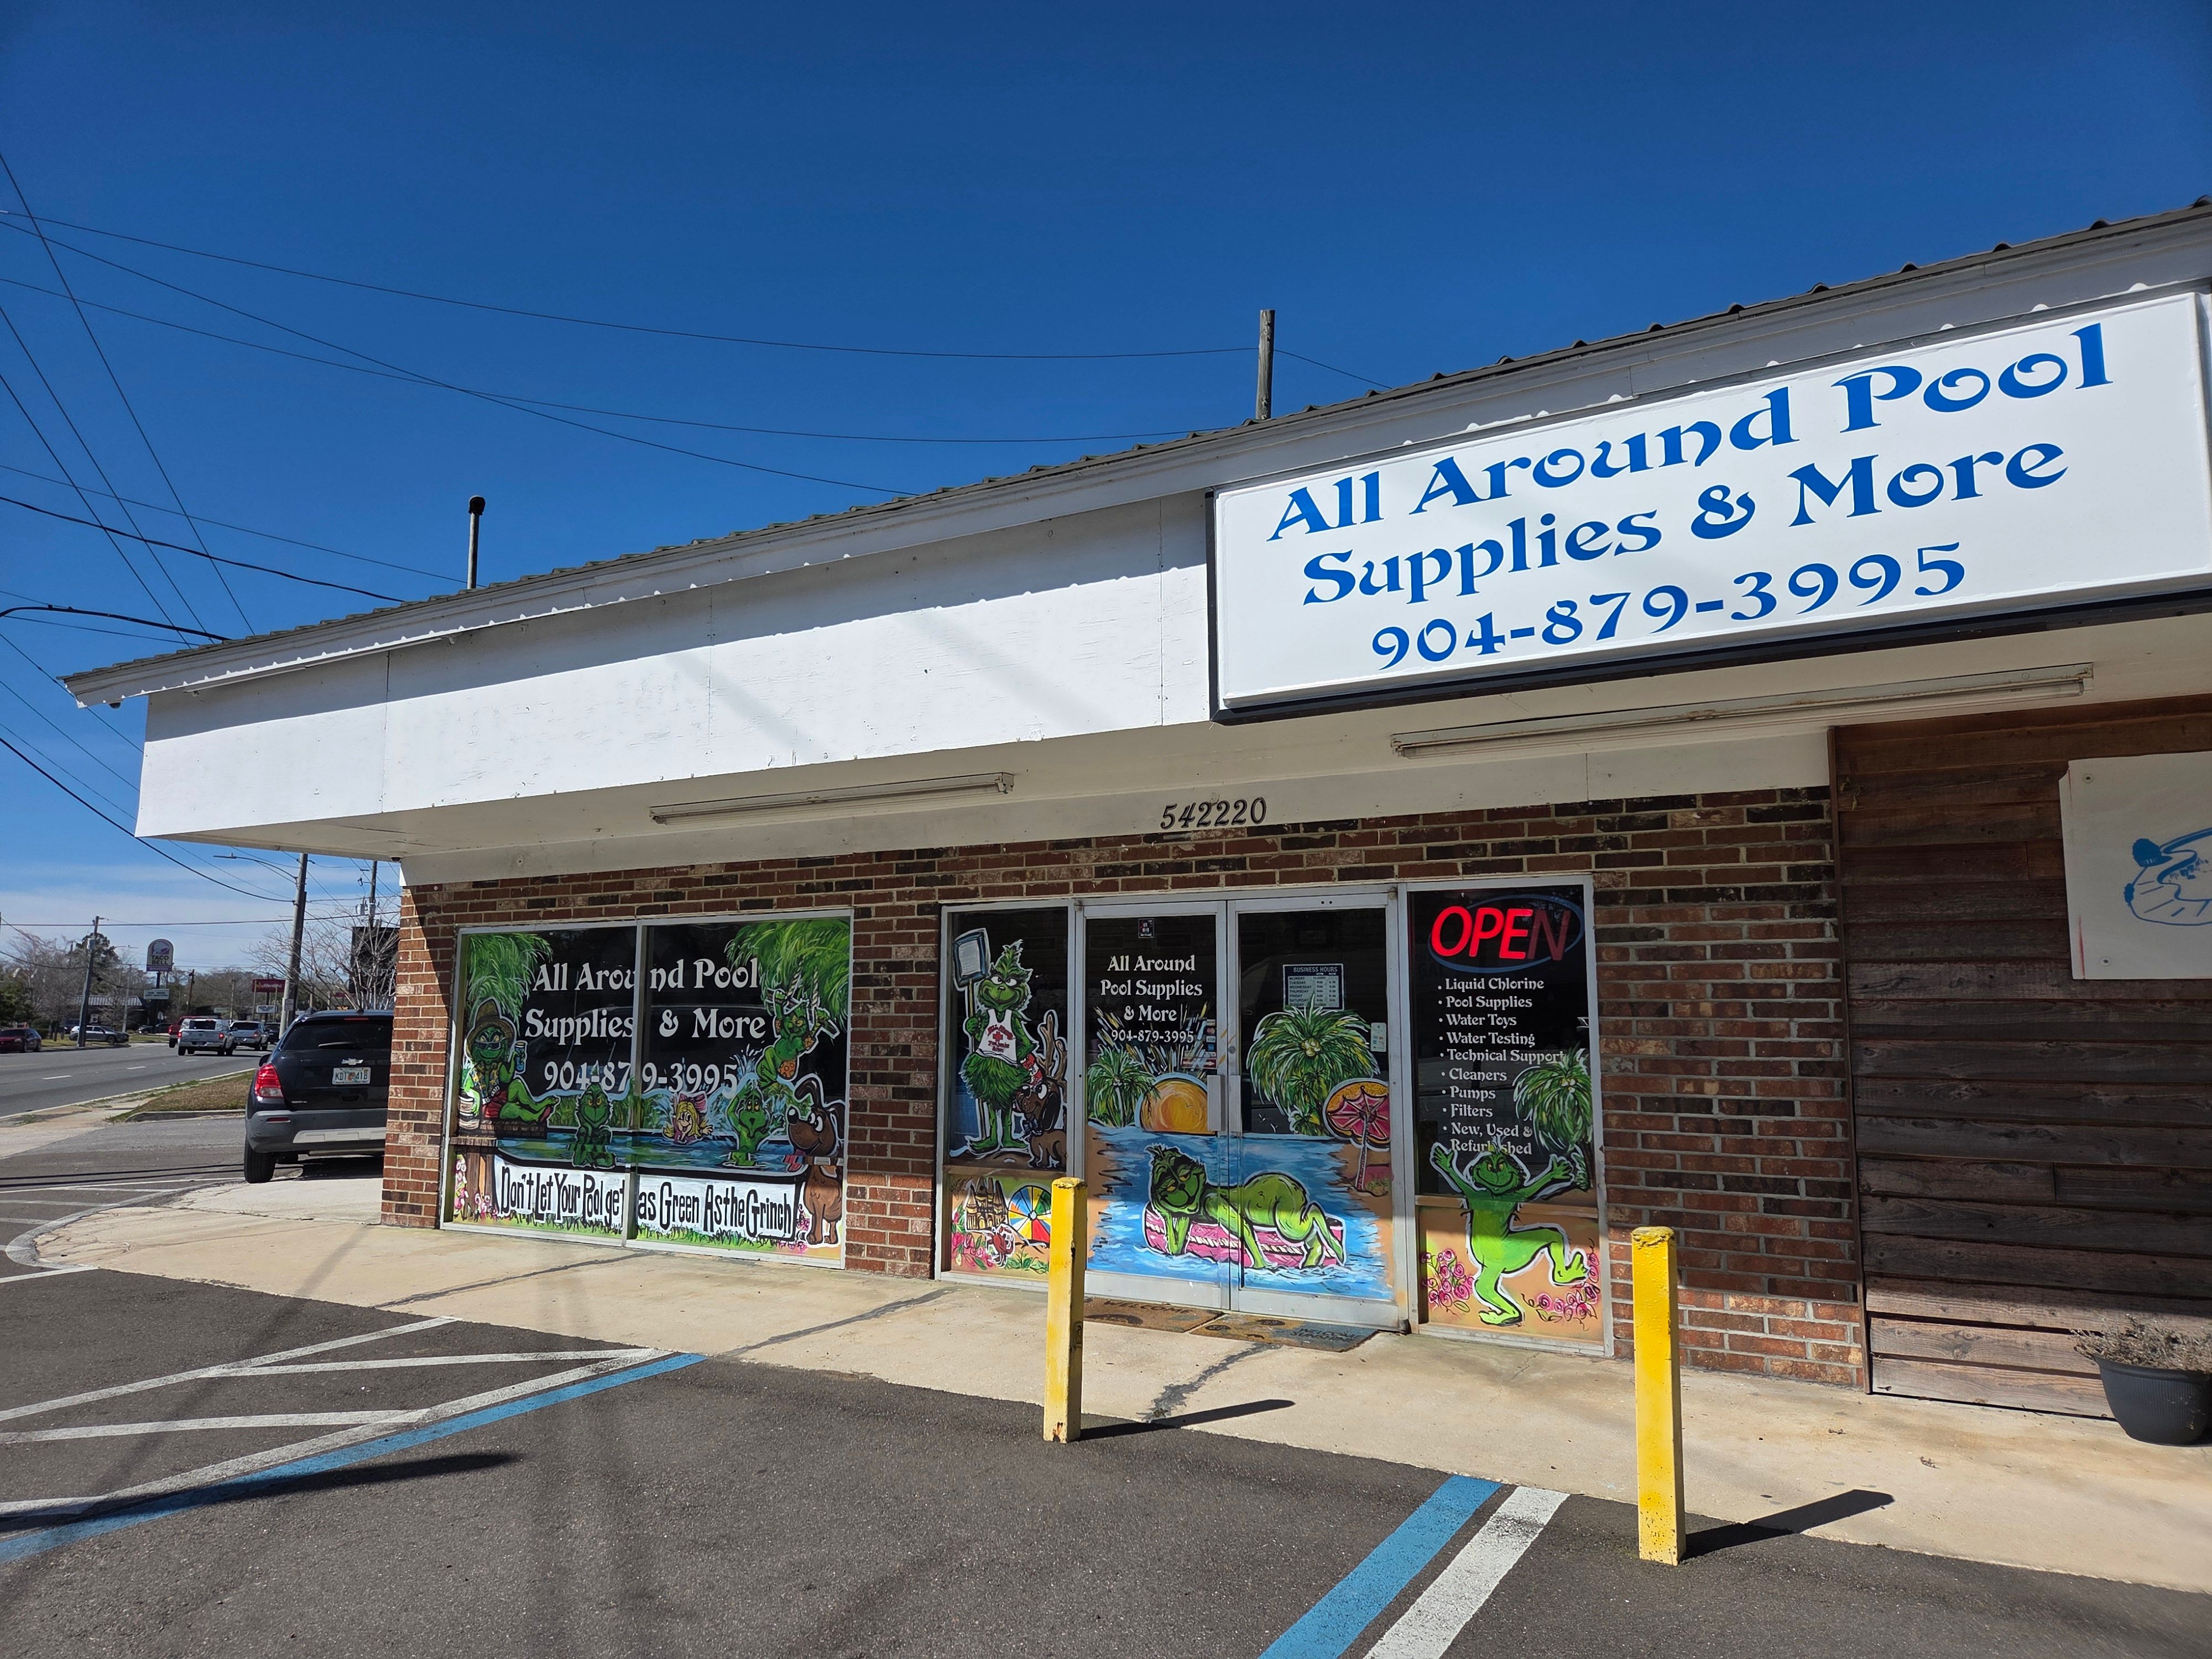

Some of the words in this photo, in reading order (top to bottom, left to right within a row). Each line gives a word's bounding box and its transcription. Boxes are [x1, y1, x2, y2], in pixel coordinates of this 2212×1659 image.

[1266, 471, 1385, 542] All
[1408, 387, 1799, 515] Around
[1831, 322, 2114, 434] Pool
[1303, 509, 1662, 606] Supplies
[1691, 484, 1755, 540] &
[1787, 443, 2069, 527] More
[1372, 541, 1965, 670] 904-879-3995
[1160, 796, 1266, 830] 542220
[1431, 906, 1571, 961] OPEN
[1107, 955, 1129, 971] All
[1133, 954, 1196, 972] Around
[532, 962, 568, 991] All
[693, 957, 758, 989] Pool
[1100, 979, 1131, 995] Pool
[1135, 979, 1203, 1000] Supplies
[1445, 978, 1485, 992] Liquid
[1488, 977, 1545, 990] Chlorine
[1446, 996, 1473, 1008] Pool
[1475, 995, 1533, 1010] Supplies
[1123, 1005, 1134, 1021] &
[1138, 1004, 1177, 1021] More
[524, 1008, 635, 1046] Supplies
[659, 1009, 679, 1037] &
[692, 1008, 766, 1039] More
[1446, 1014, 1485, 1025] Water
[1488, 1014, 1517, 1029] Toys
[1111, 1029, 1194, 1043] 904-879-3995
[1446, 1032, 1486, 1044] Water
[1488, 1032, 1535, 1047] Testing
[1447, 1048, 1507, 1062] Technical
[1510, 1049, 1564, 1065] Support
[544, 1061, 738, 1099] 904-879-3995
[1449, 1068, 1507, 1082] Cleaners
[1449, 1086, 1496, 1102] Pumps
[1451, 1103, 1493, 1118] Filters
[1451, 1122, 1483, 1137] New,
[1486, 1124, 1519, 1137] Used
[1522, 1126, 1533, 1138] &
[1450, 1138, 1532, 1155] Refurbshed
[500, 1166, 534, 1214] Don't
[535, 1173, 554, 1221] Let
[554, 1173, 581, 1220] Your
[582, 1173, 603, 1221] Pool
[638, 1191, 656, 1221] as
[659, 1182, 700, 1230] Green
[746, 1189, 791, 1238] Grinch
[1103, 1301, 1194, 1314] WELCOME
